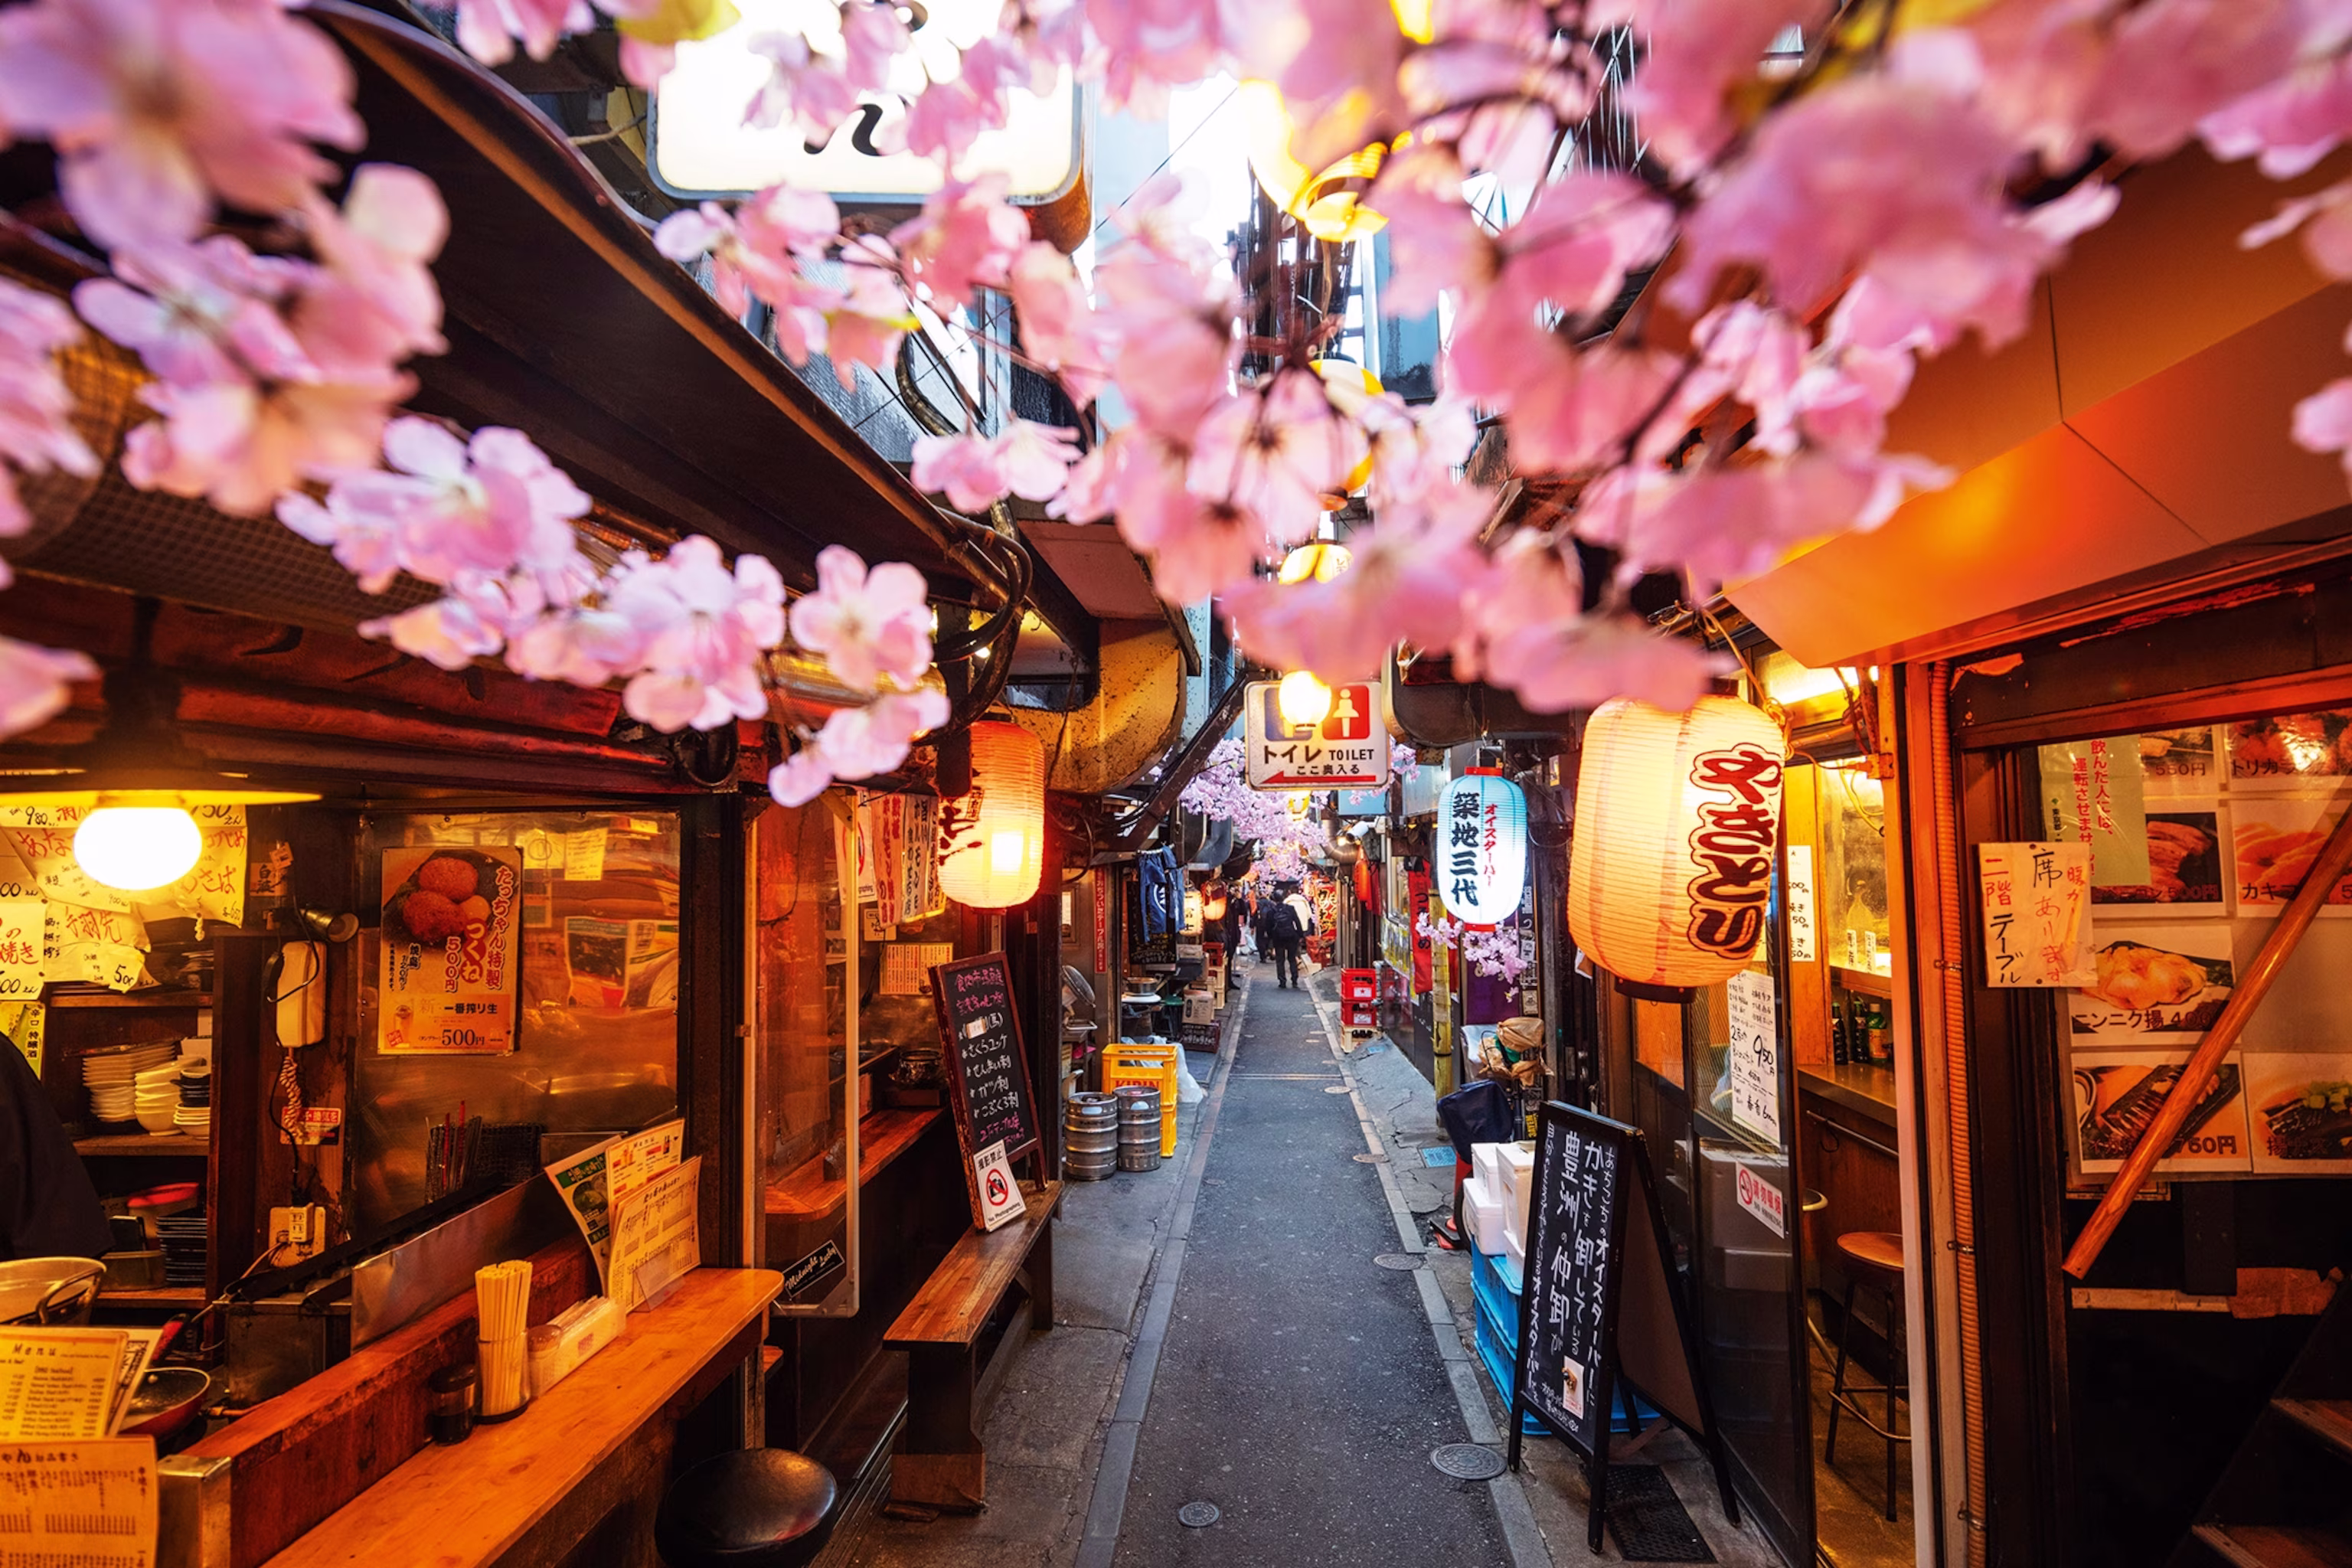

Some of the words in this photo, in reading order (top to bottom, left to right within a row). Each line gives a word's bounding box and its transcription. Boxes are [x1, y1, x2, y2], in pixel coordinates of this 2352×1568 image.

[1264, 745, 1321, 764] トイレ
[1328, 749, 1375, 760] TOILET
[1296, 764, 1360, 775] ここ奥入る
[17, 828, 76, 858] あな
[1450, 792, 1479, 906] 築地三代
[1483, 804, 1498, 887] オイスターバー
[462, 921, 486, 981] つくね
[487, 867, 514, 989] たっちゃん特製
[1983, 858, 2023, 984] 二階テーブル
[446, 938, 460, 992] 500円
[1549, 1131, 1580, 1355] 豊洲の仲卸が
[1572, 1141, 1604, 1355] かきを卸している
[12, 1344, 57, 1357] Menu
